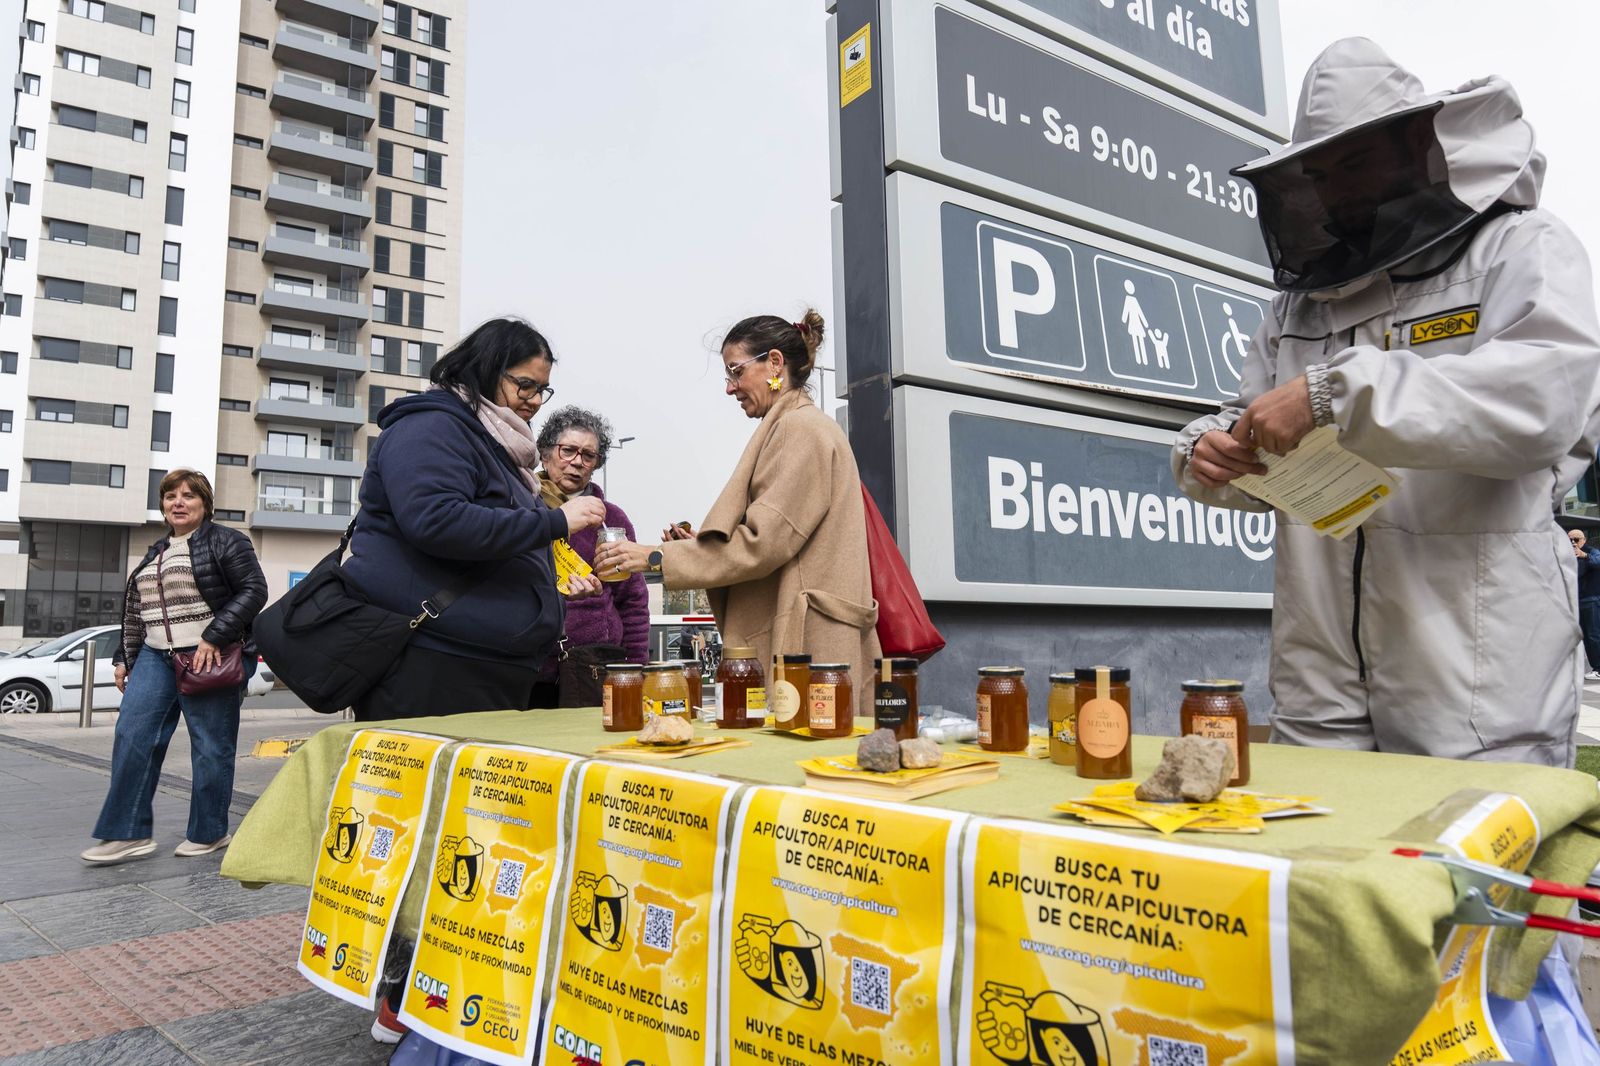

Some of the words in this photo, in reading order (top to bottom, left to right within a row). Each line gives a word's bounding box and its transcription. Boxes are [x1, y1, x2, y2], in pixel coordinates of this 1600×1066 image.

[1127, 0, 1155, 30] al
[1166, 4, 1213, 60] día
[966, 74, 1006, 125] Lu
[1020, 112, 1030, 125] -
[1042, 106, 1080, 153] Sa
[1091, 126, 1157, 181] 9:00
[1168, 170, 1177, 181] -
[1186, 164, 1257, 219] 21:30
[993, 237, 1056, 349] P
[1412, 315, 1475, 341] LYSON
[352, 749, 425, 770] APICULTOR/APICULTORA
[376, 739, 398, 750] BUSCA
[399, 742, 410, 752] TU
[360, 764, 370, 774] DE
[486, 756, 513, 771] BUSCA
[515, 761, 528, 772] TU
[458, 767, 553, 795] APICULTOR/APICULTORA
[473, 785, 483, 797] DE
[482, 786, 526, 806] CERCANÍA:
[621, 780, 655, 799] BUSCA
[659, 787, 674, 802] TU
[587, 792, 709, 831] APICULTOR/APICULTORA
[802, 808, 849, 831] BUSCA
[856, 819, 876, 837] TU
[608, 815, 621, 829] DE
[623, 818, 677, 843] CERCANÍA:
[597, 838, 683, 869] www.coag.org/apicultura
[753, 820, 931, 873] APICULTOR/APICULTORA
[785, 849, 802, 866] DE
[806, 854, 884, 886] CERCANÍA:
[1055, 856, 1122, 885] BUSCA
[1131, 870, 1161, 891] TU
[330, 879, 338, 891] DE
[338, 883, 350, 896] LAS
[350, 887, 386, 907] MEZCLAS
[770, 875, 899, 917] www.coag.org/apicultura
[988, 870, 1249, 937] APICULTOR/APICULTORA
[323, 896, 339, 911] VERDAD
[343, 905, 351, 915] DE
[351, 907, 386, 927] PROXIMIDAD
[306, 925, 328, 948] COAG
[430, 913, 447, 930] HUYE
[447, 920, 458, 934] DE
[459, 924, 476, 940] LAS
[477, 929, 525, 953] MEZCLAS
[1038, 905, 1061, 926] DE
[1068, 912, 1184, 952] CERCANÍA:
[432, 935, 439, 947] DE
[439, 939, 463, 956] VERDAD
[464, 948, 470, 958] Y
[470, 951, 480, 962] DE
[481, 954, 532, 977] PROXIMIDAD
[1020, 938, 1206, 991] www.coag.org/apicultura
[345, 965, 369, 984] CECU
[414, 971, 450, 1000] COAG
[568, 959, 592, 981] HUYE
[592, 971, 605, 988] DE
[606, 977, 627, 996] LAS
[629, 985, 689, 1015] MEZCLAS
[559, 979, 574, 996] MIEL
[574, 987, 582, 1001] DE
[583, 992, 613, 1014] VERDAD
[615, 1006, 622, 1017] Y
[623, 1009, 635, 1022] DE
[636, 1013, 700, 1041] PROXIMIDAD
[482, 1020, 519, 1042] CECU
[554, 1024, 602, 1063] COAG
[745, 1016, 783, 1042] HUYE
[787, 1031, 805, 1049] DE
[809, 1038, 837, 1061] LAS
[841, 1049, 892, 1066] MEZ
[1413, 1041, 1434, 1063] LAS
[1433, 1020, 1478, 1051] MEZCLAS
[734, 1038, 759, 1057] MIEL
[761, 1048, 775, 1063] DE
